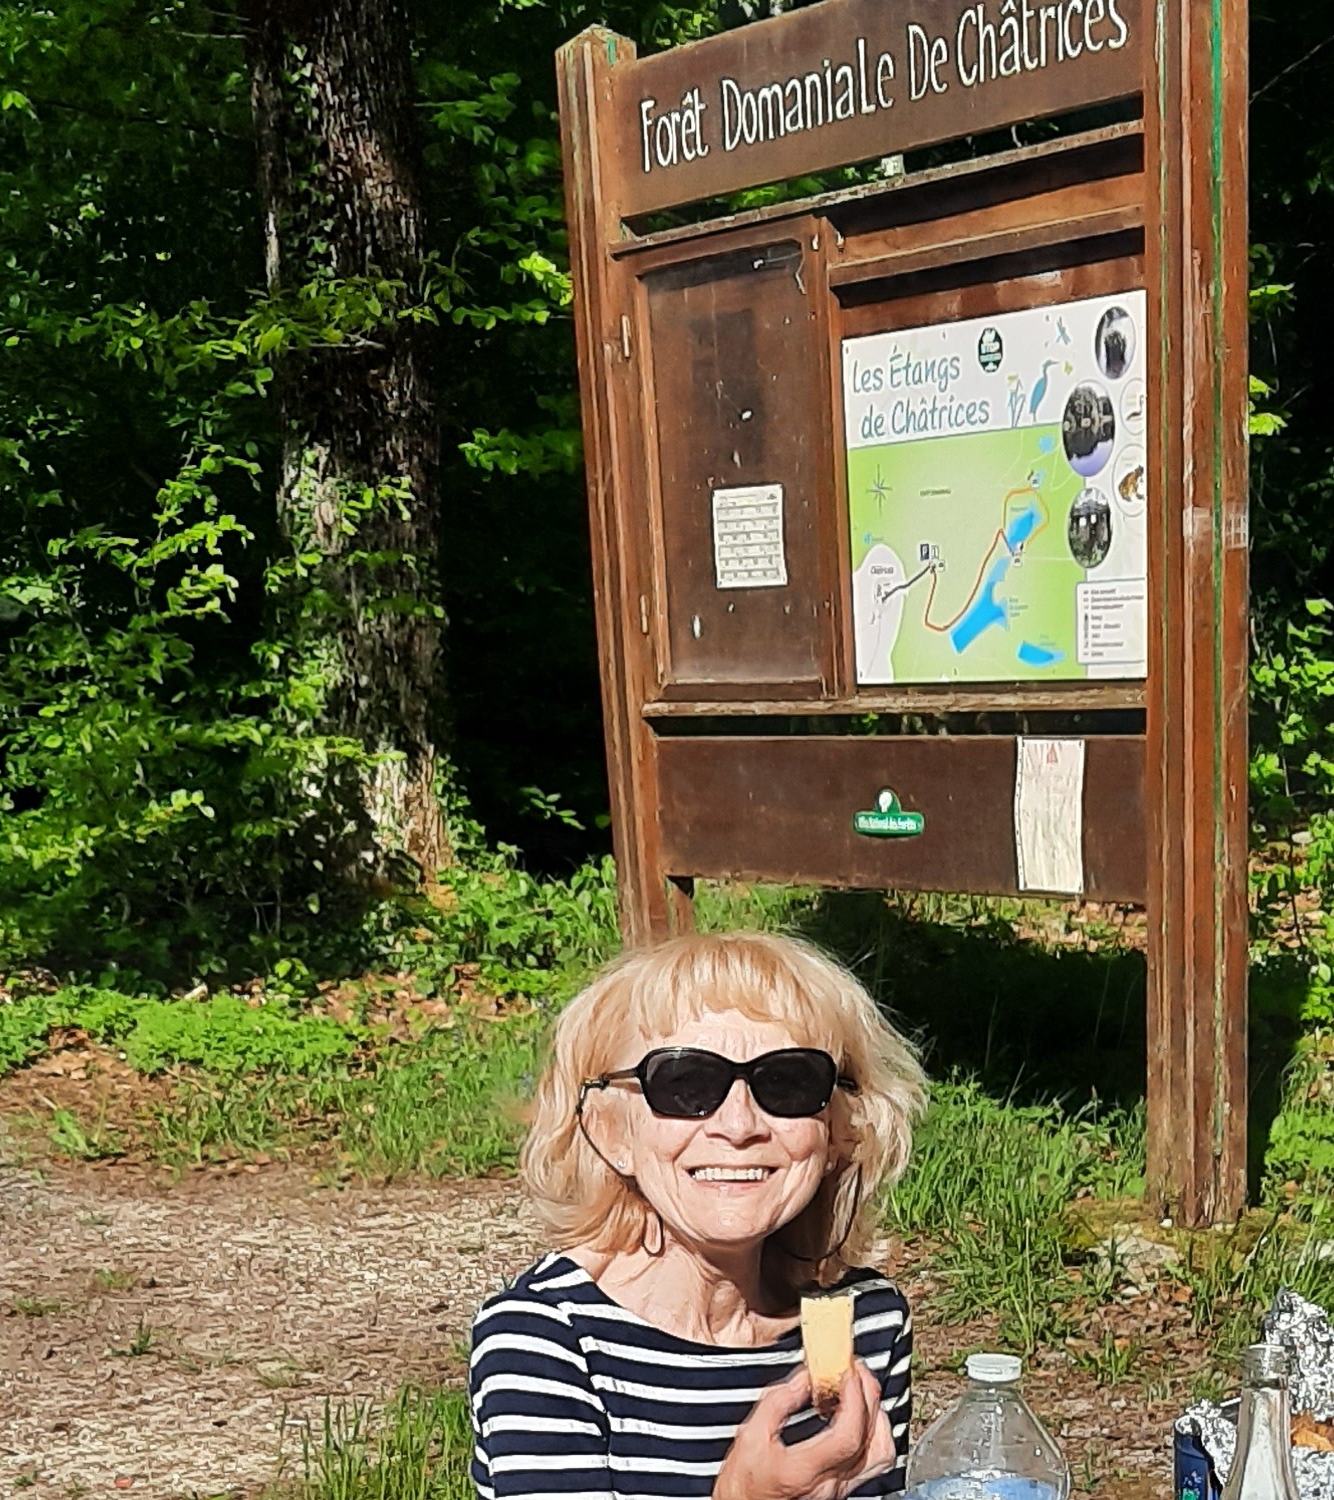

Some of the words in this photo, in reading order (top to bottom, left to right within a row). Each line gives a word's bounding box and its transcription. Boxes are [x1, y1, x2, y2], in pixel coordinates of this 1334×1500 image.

[641, 88, 709, 172] Forêt
[907, 24, 948, 100] De
[957, 0, 1128, 86] Châtrices
[889, 345, 960, 393] Étangs
[861, 404, 885, 439] de
[891, 394, 990, 434] Châtrices
